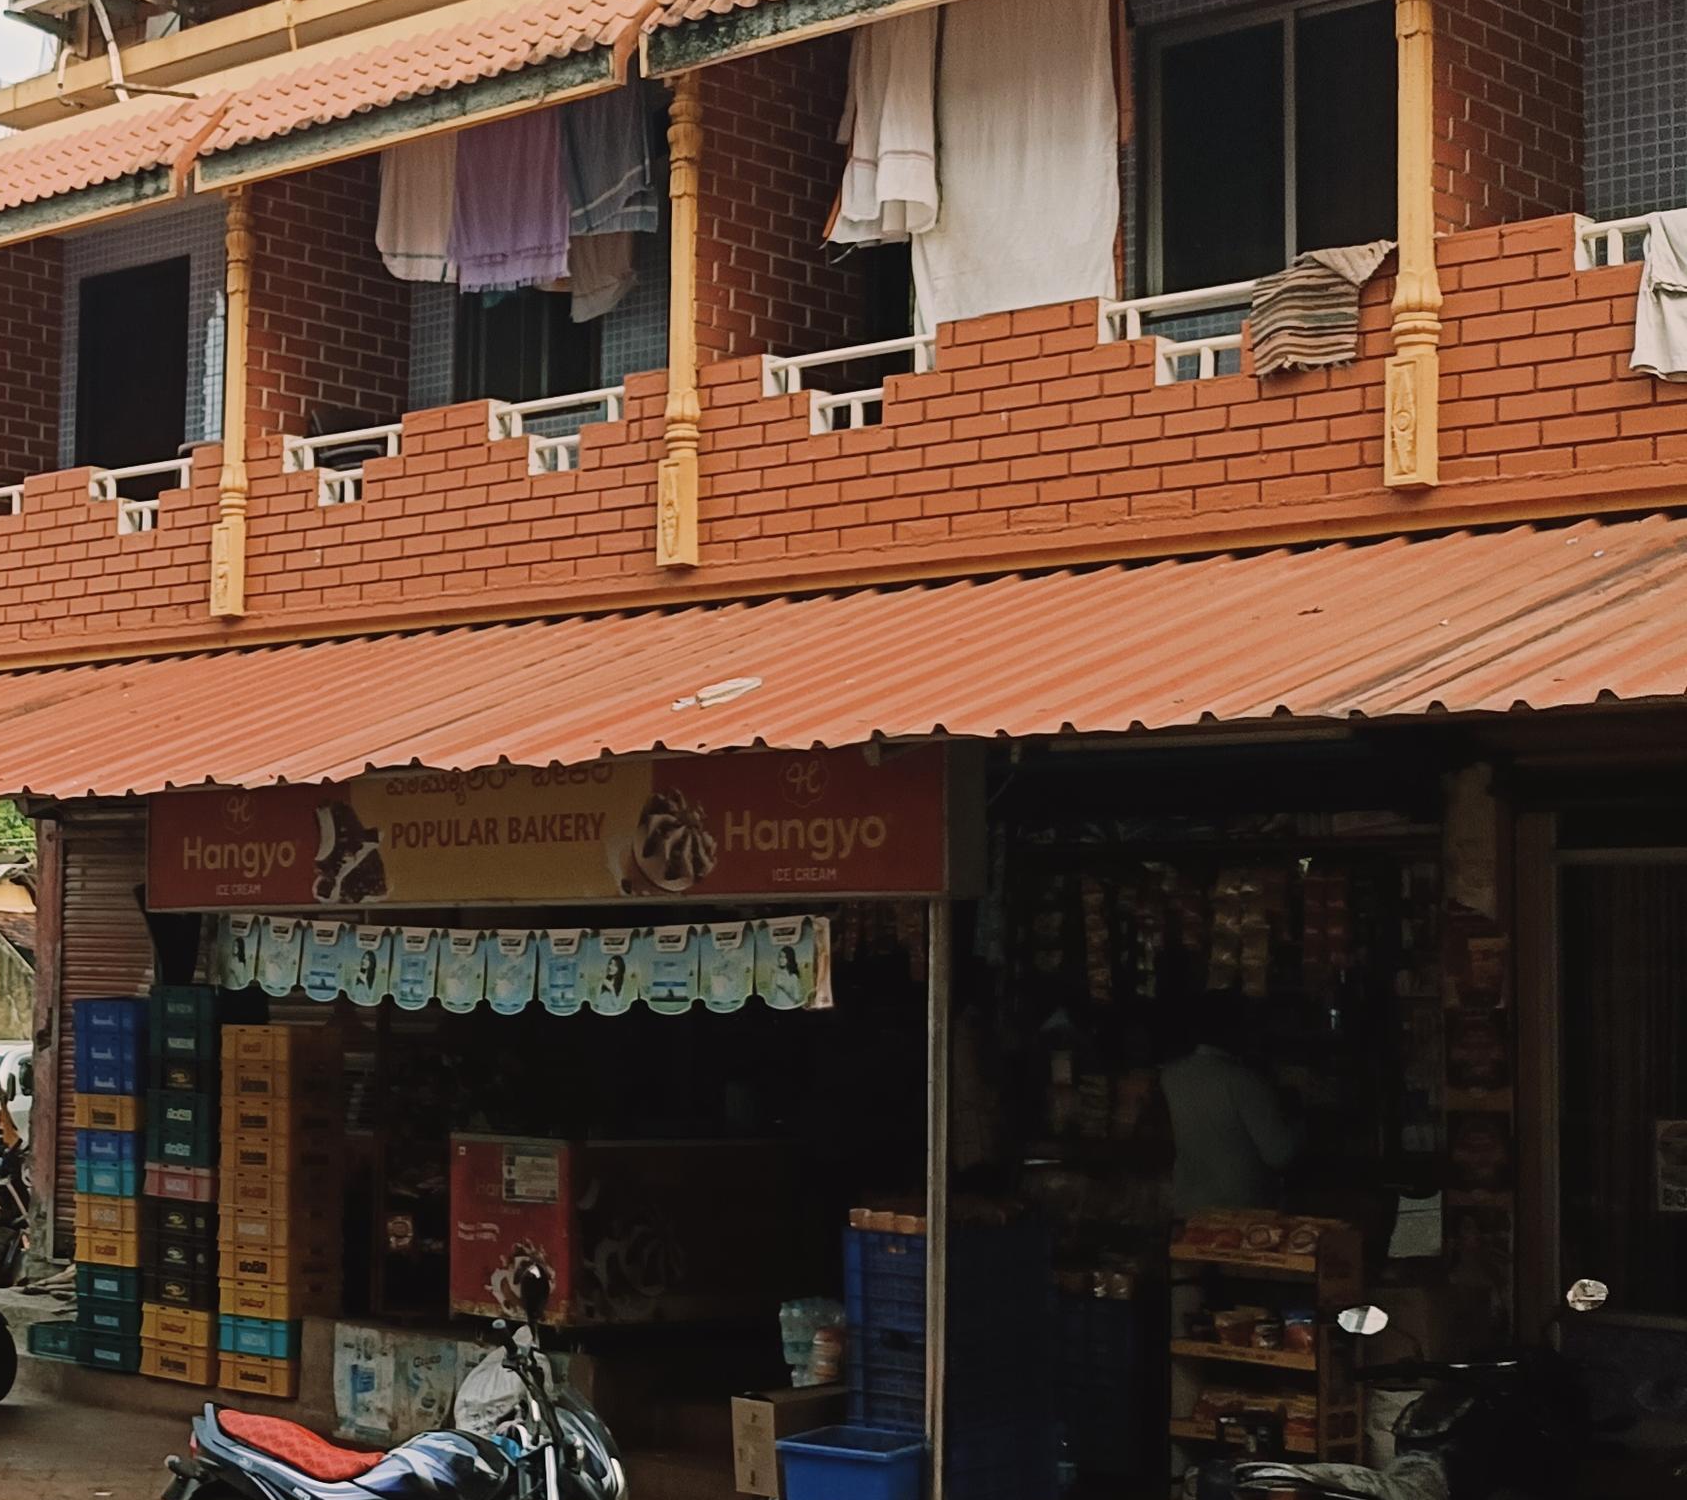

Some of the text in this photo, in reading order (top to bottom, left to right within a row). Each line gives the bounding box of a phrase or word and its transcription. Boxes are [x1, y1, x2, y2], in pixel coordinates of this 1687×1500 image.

[391, 811, 606, 849] POPULAR BAKERY
[724, 809, 888, 861] Hangyo
[182, 835, 297, 879] Hangyo
[772, 866, 838, 883] ICE CREAM
